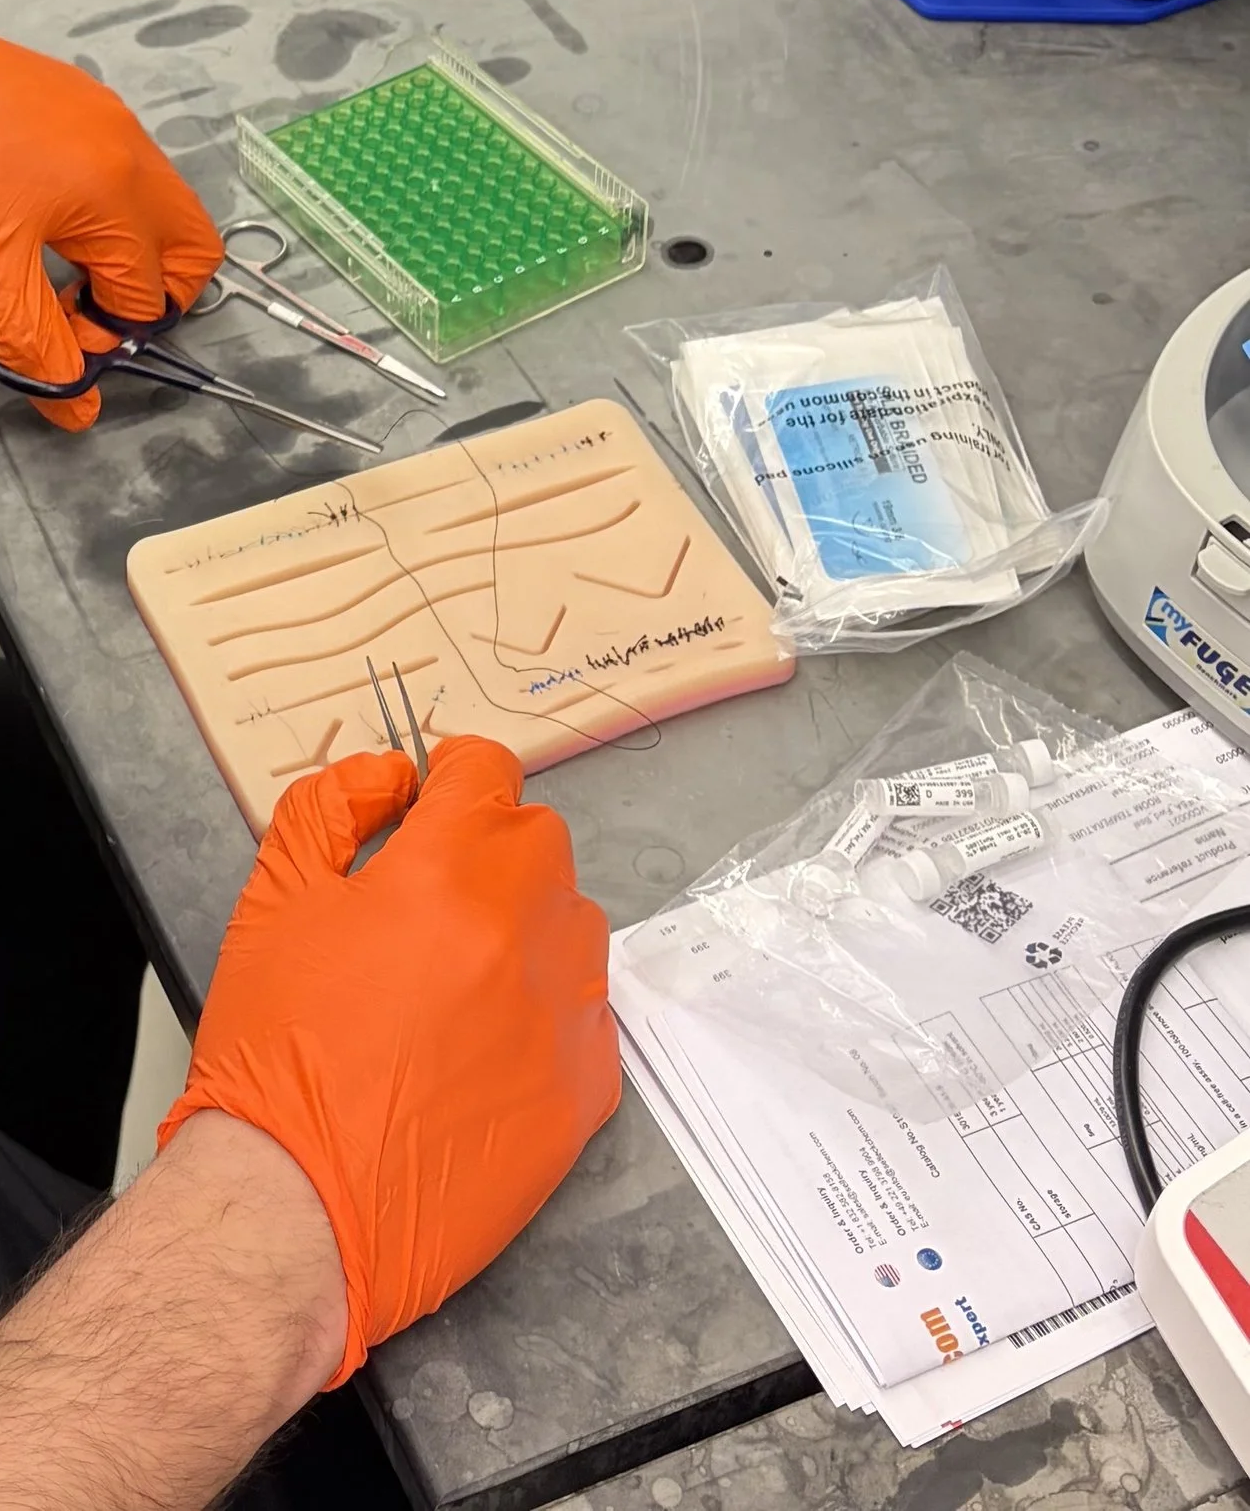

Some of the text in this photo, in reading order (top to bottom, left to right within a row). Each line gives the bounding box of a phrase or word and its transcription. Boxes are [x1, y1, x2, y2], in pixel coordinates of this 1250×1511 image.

[885, 384, 980, 427] expiration
[911, 384, 931, 402] in
[783, 410, 815, 432] the
[816, 407, 845, 430] for
[752, 466, 788, 488] pad
[790, 450, 865, 483] silicone
[954, 786, 974, 800] 399
[1065, 790, 1163, 850] ROOM TEMPERATURE
[1192, 822, 1226, 850] Name
[1142, 834, 1238, 893] Product reference
[710, 967, 732, 983] 399
[1150, 1008, 1170, 1031] more
[1165, 1025, 1193, 1061] 100-fold
[903, 1127, 919, 1146] No.
[913, 1142, 943, 1180] Catalog
[855, 1166, 907, 1238] Order & Inquiry
[1013, 1194, 1043, 1233] CAS No.
[1044, 1184, 1073, 1222] storage
[814, 1184, 866, 1256] Order & Inquiry
